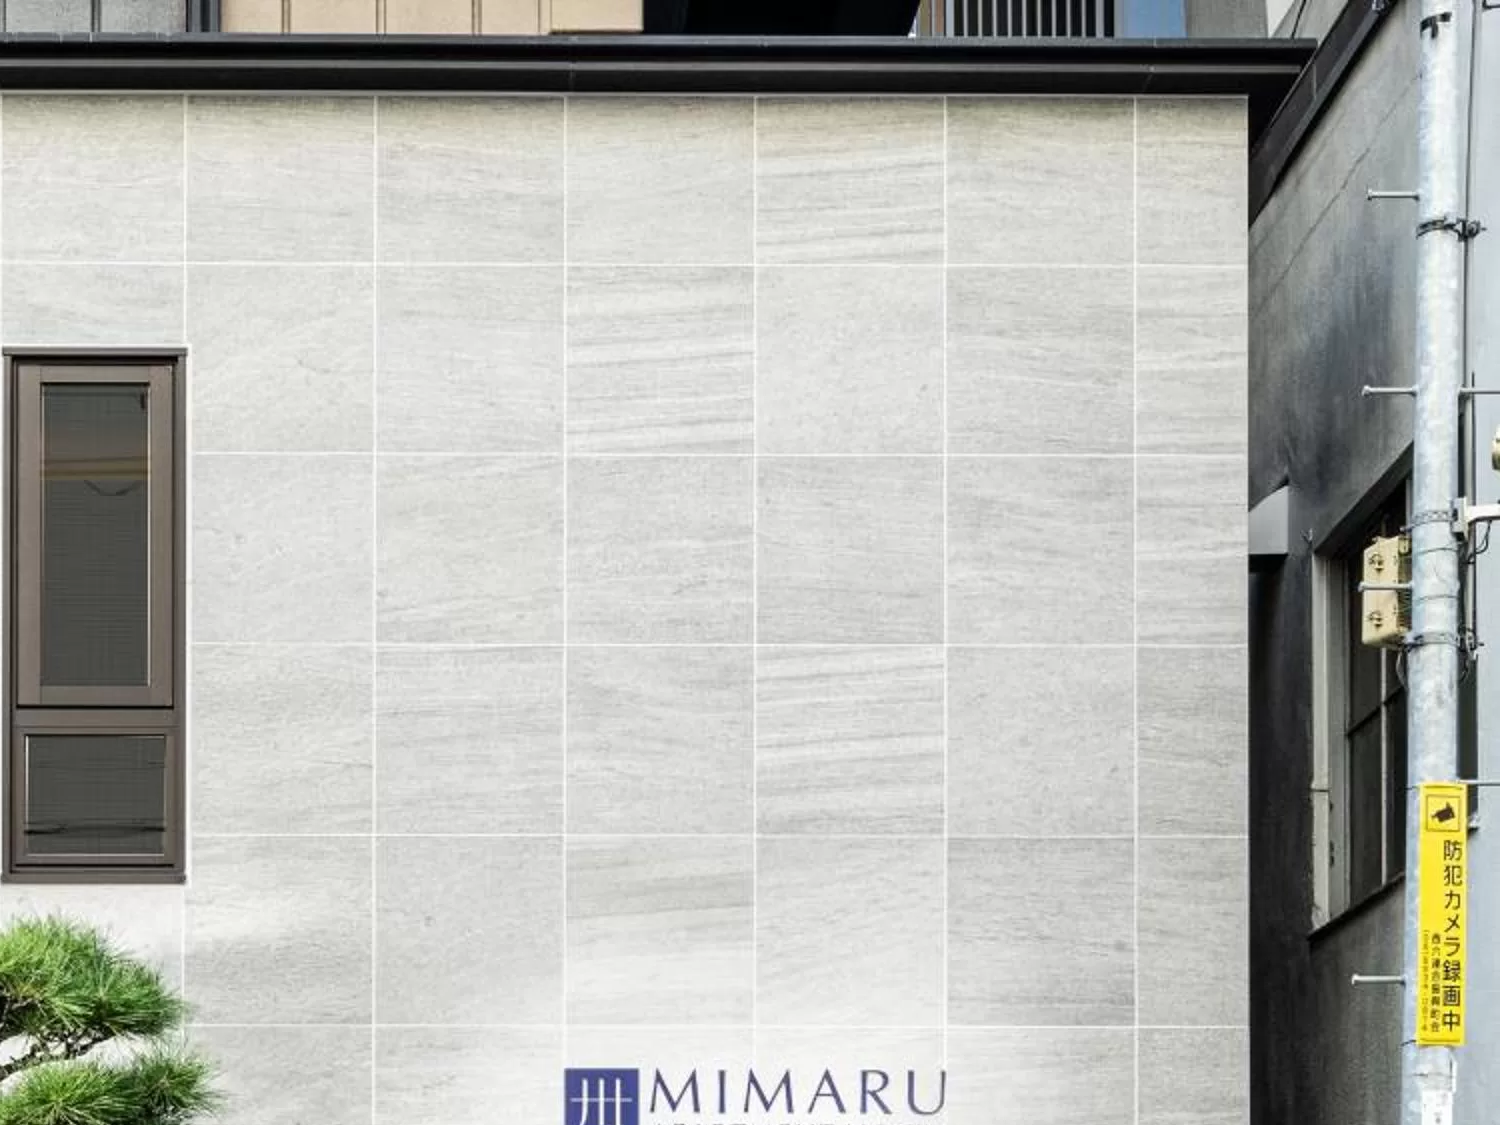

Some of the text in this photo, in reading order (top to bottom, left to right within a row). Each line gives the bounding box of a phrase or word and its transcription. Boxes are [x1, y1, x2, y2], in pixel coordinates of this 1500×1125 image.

[1442, 839, 1463, 1032] 防犯カメラ録画中
[649, 1068, 947, 1116] MIMARU
